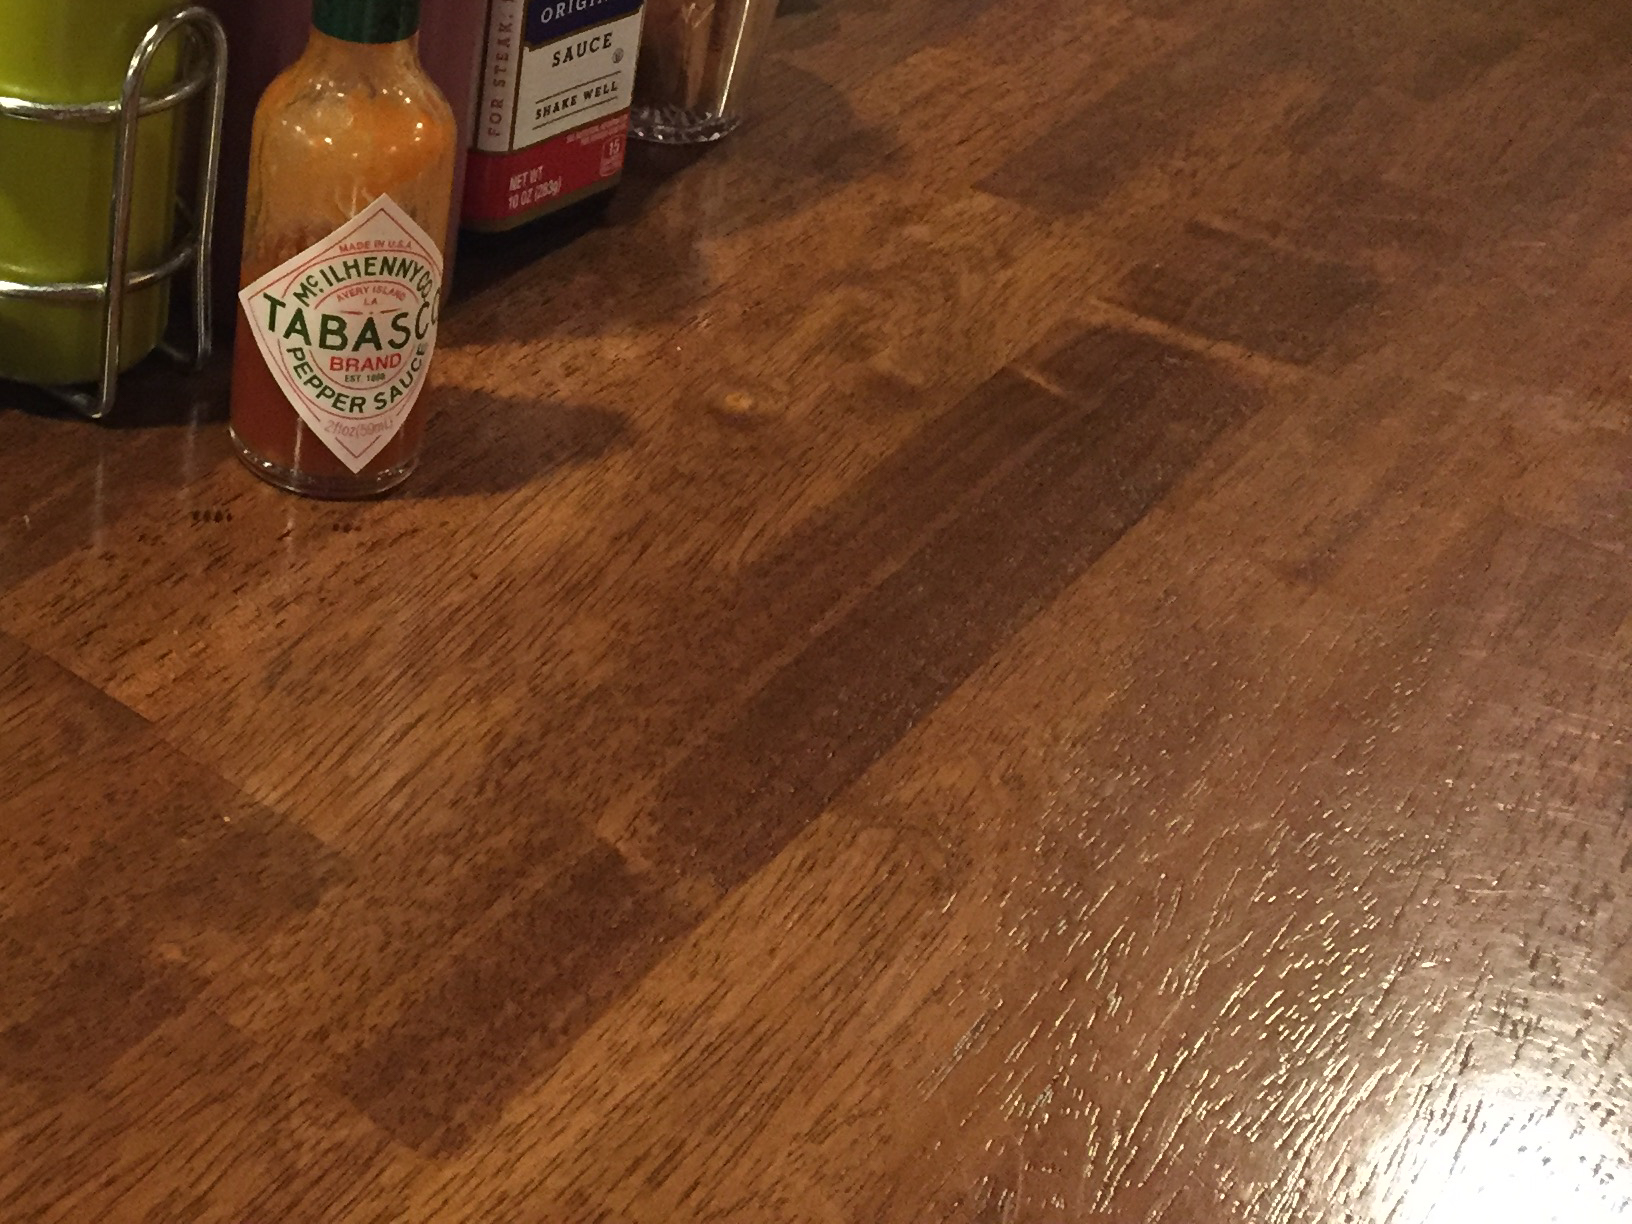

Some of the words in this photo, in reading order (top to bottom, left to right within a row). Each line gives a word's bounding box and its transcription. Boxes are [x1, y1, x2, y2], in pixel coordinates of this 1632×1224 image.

[551, 32, 614, 68] SAUCE
[535, 94, 578, 121] SHAKE
[583, 80, 619, 102] WELL
[488, 98, 504, 138] FOR
[509, 173, 528, 192] NET
[508, 193, 520, 210] 10
[520, 187, 533, 207] OZ
[339, 240, 372, 254] MADE
[374, 240, 385, 249] IN
[335, 287, 370, 303] AVERY
[372, 285, 407, 302] ISLAND
[329, 353, 403, 372] BRAND
[285, 346, 366, 415] PEPPER
[373, 342, 428, 411] SAUCE
